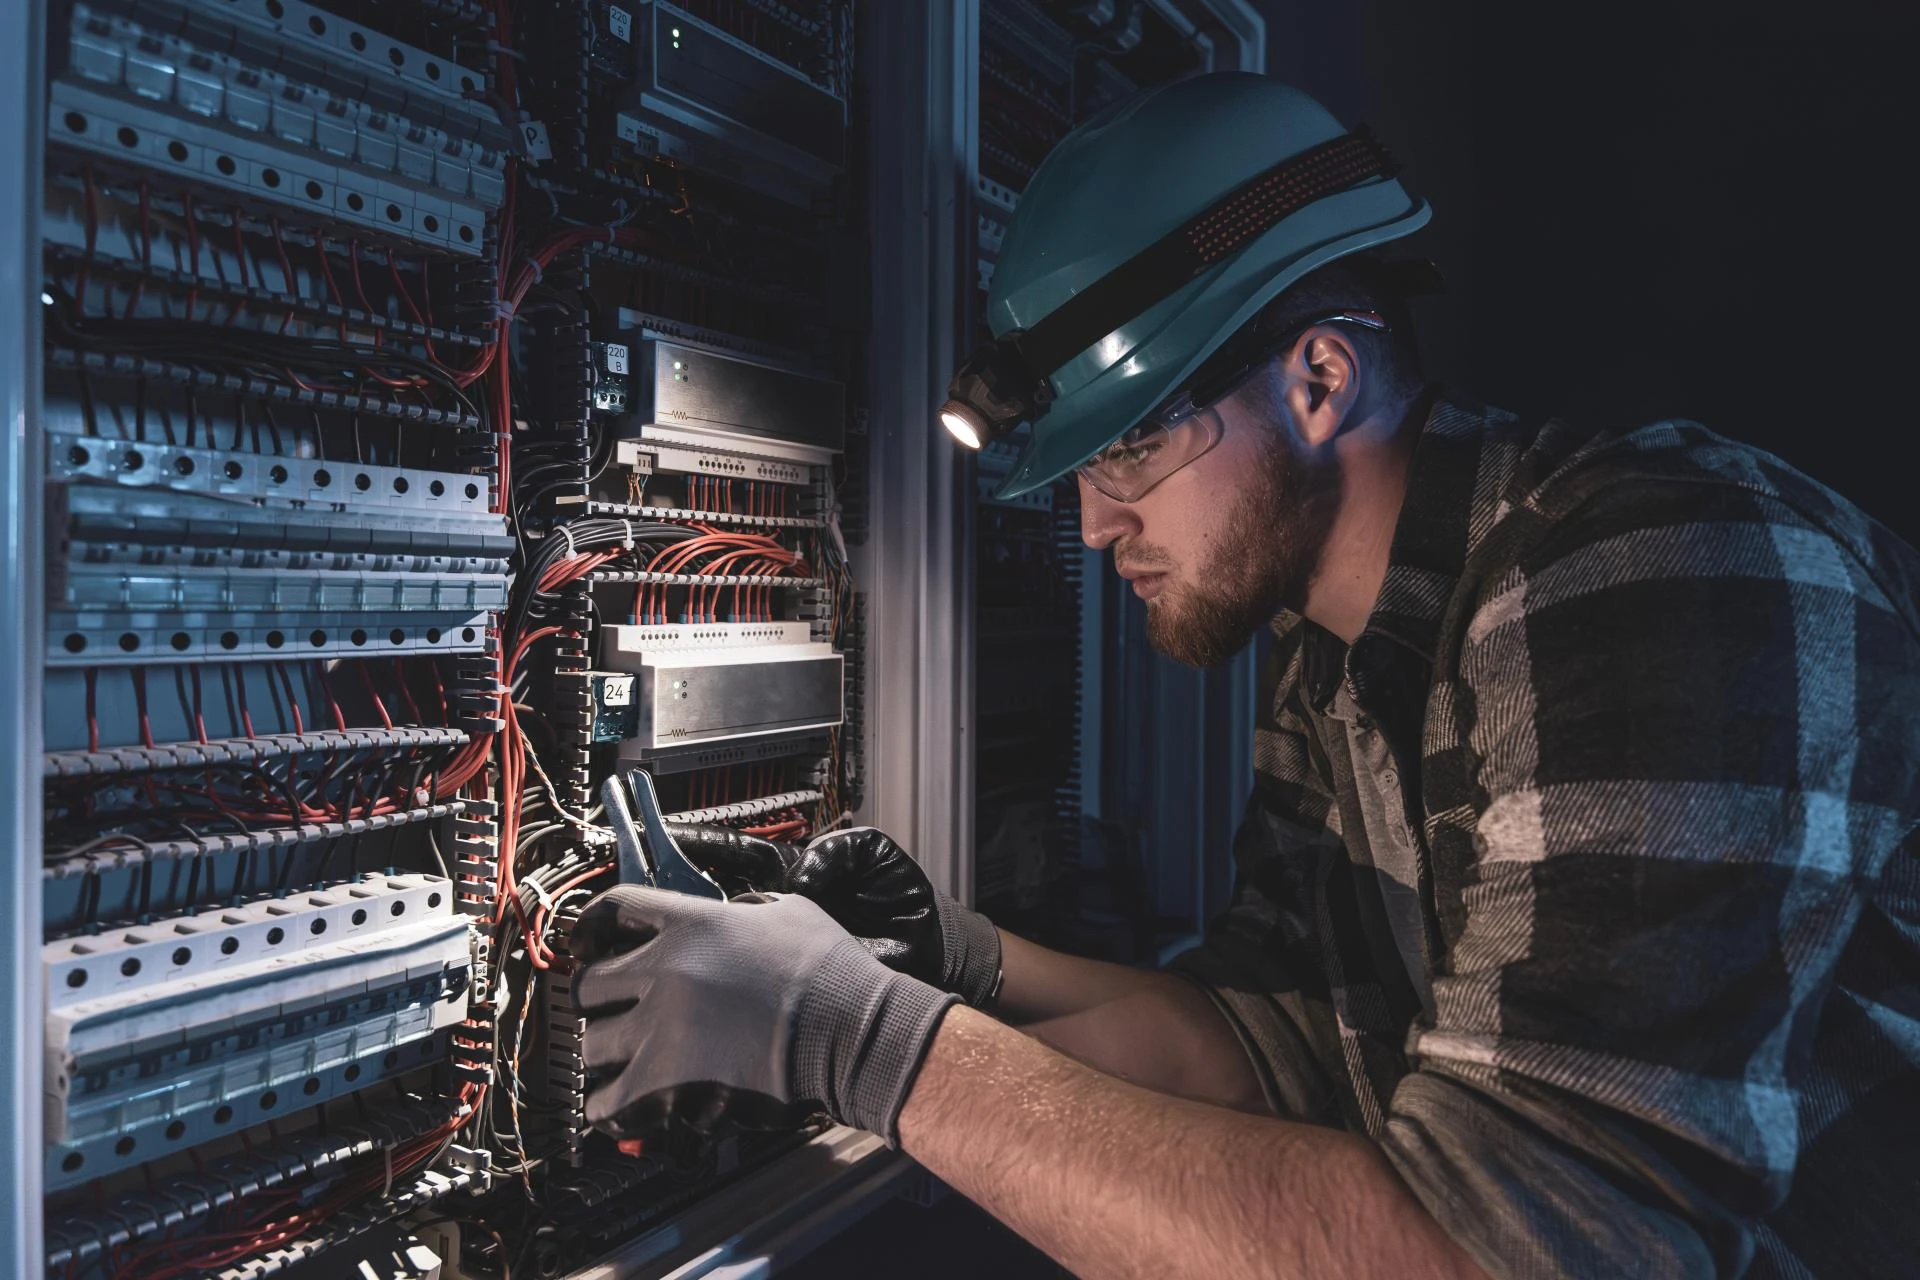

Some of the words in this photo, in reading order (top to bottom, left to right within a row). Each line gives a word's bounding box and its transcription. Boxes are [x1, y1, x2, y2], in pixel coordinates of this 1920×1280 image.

[611, 8, 627, 24] 220
[608, 346, 624, 358] 220
[616, 362, 622, 371] B
[605, 684, 624, 699] 24
